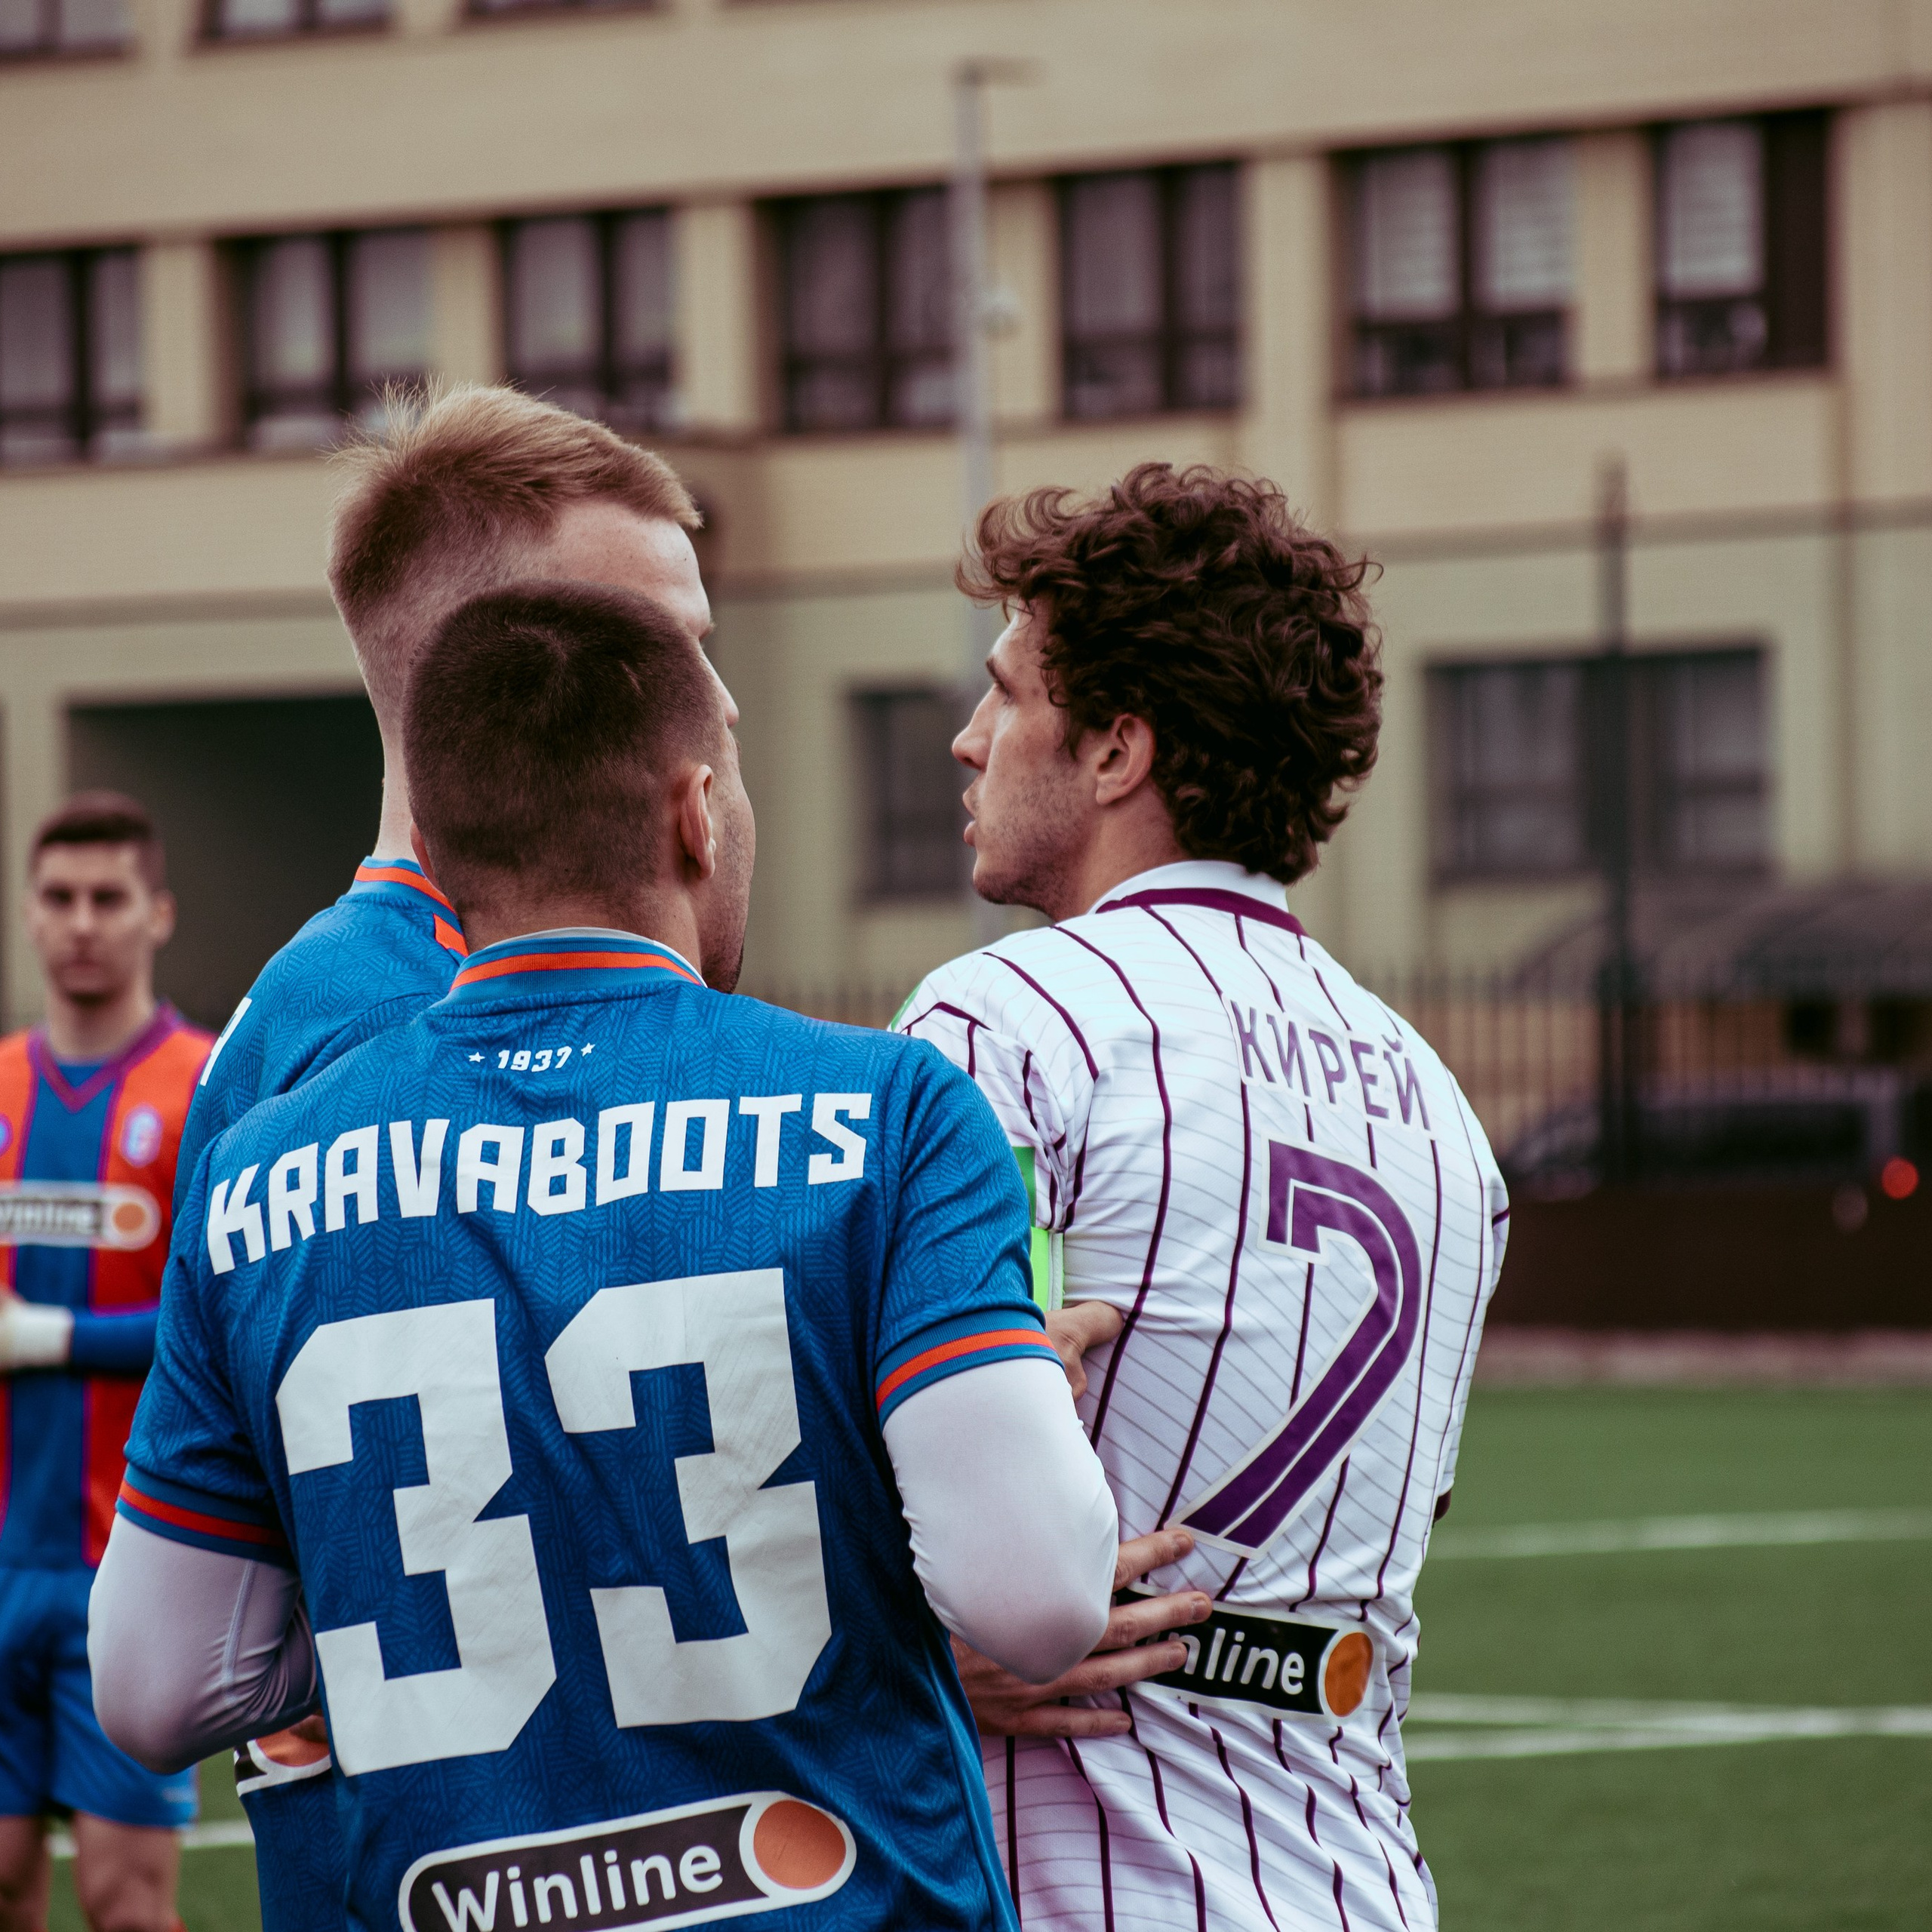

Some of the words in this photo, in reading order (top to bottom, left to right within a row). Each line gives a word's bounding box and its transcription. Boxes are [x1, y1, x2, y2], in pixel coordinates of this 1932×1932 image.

[497, 1045, 573, 1072] 1937
[1229, 999, 1432, 1132] КИРЕЙ
[207, 1092, 872, 1275] KRAVABOOTS
[275, 1267, 832, 1777] 33
[1146, 1626, 1306, 1696] nline
[430, 1844, 723, 1932] Winline
